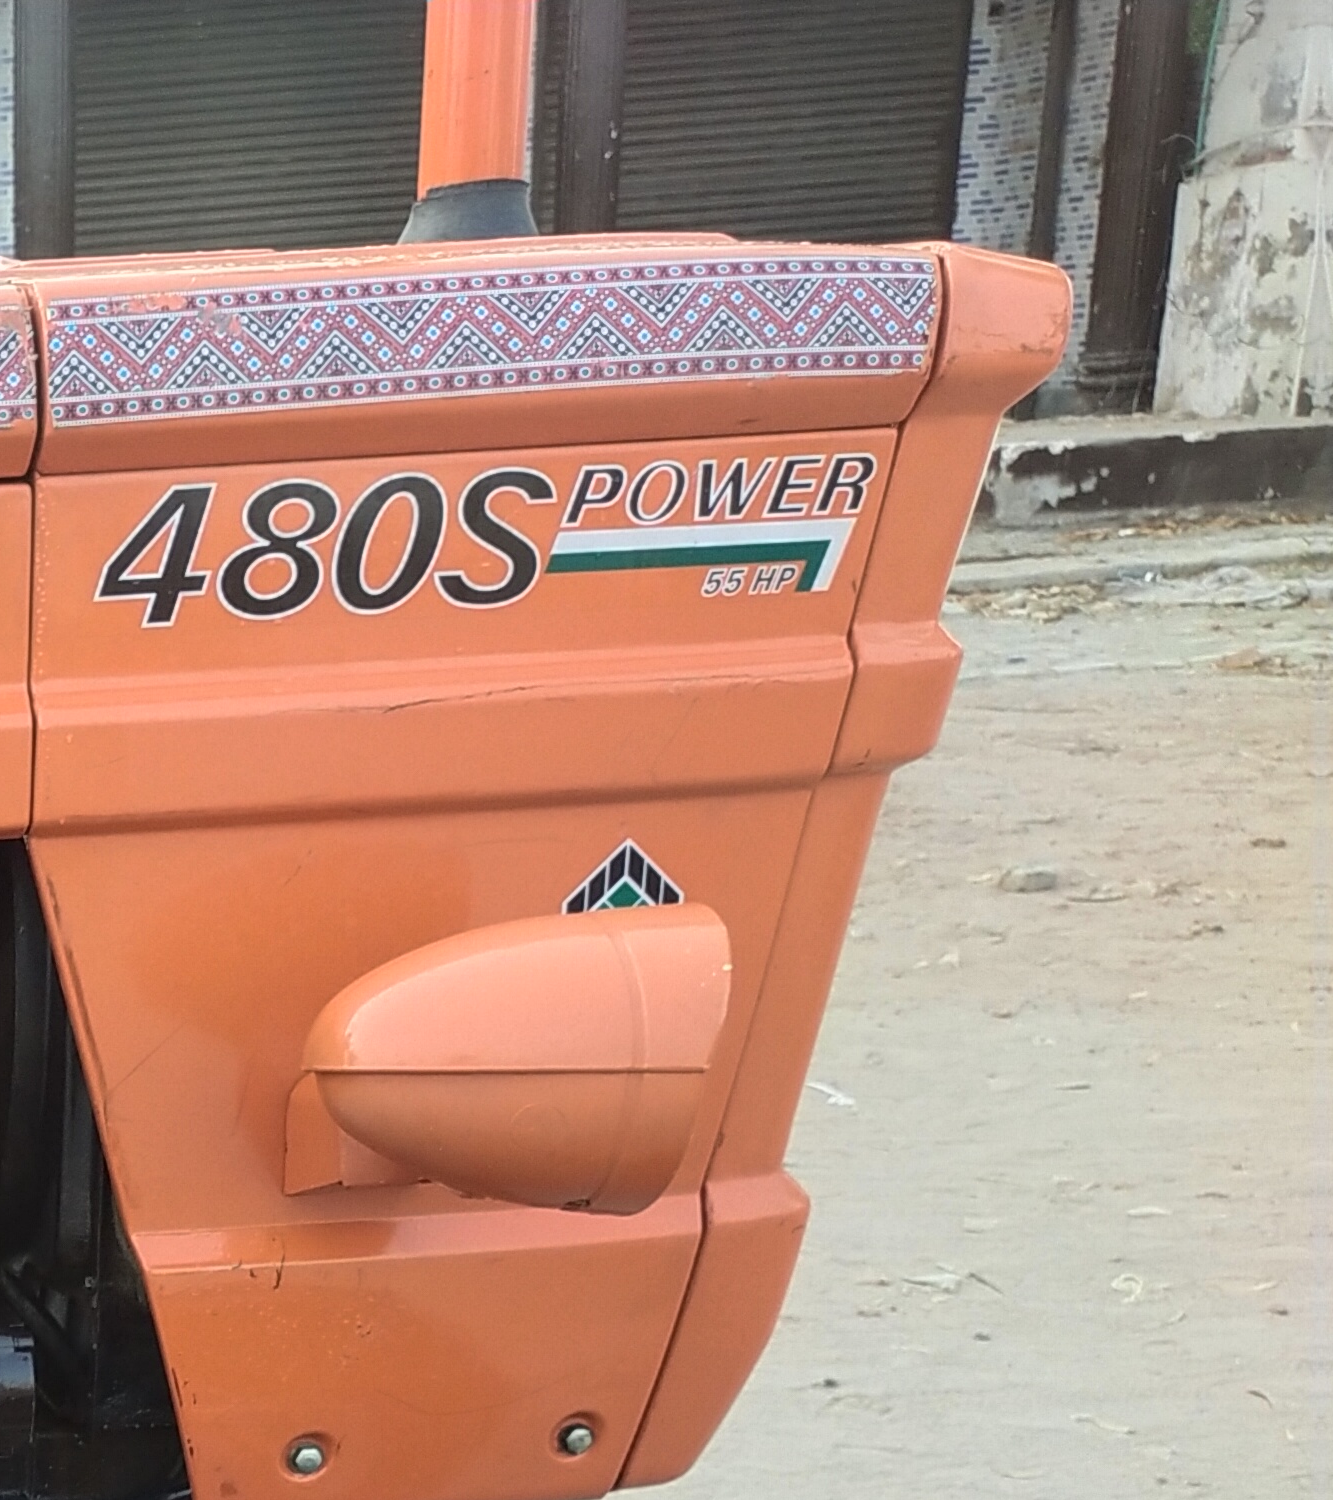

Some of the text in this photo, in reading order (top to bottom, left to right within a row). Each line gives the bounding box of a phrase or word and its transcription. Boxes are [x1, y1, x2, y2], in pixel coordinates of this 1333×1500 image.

[95, 453, 878, 627] 480S POWER
[701, 564, 797, 598] 55 HP
